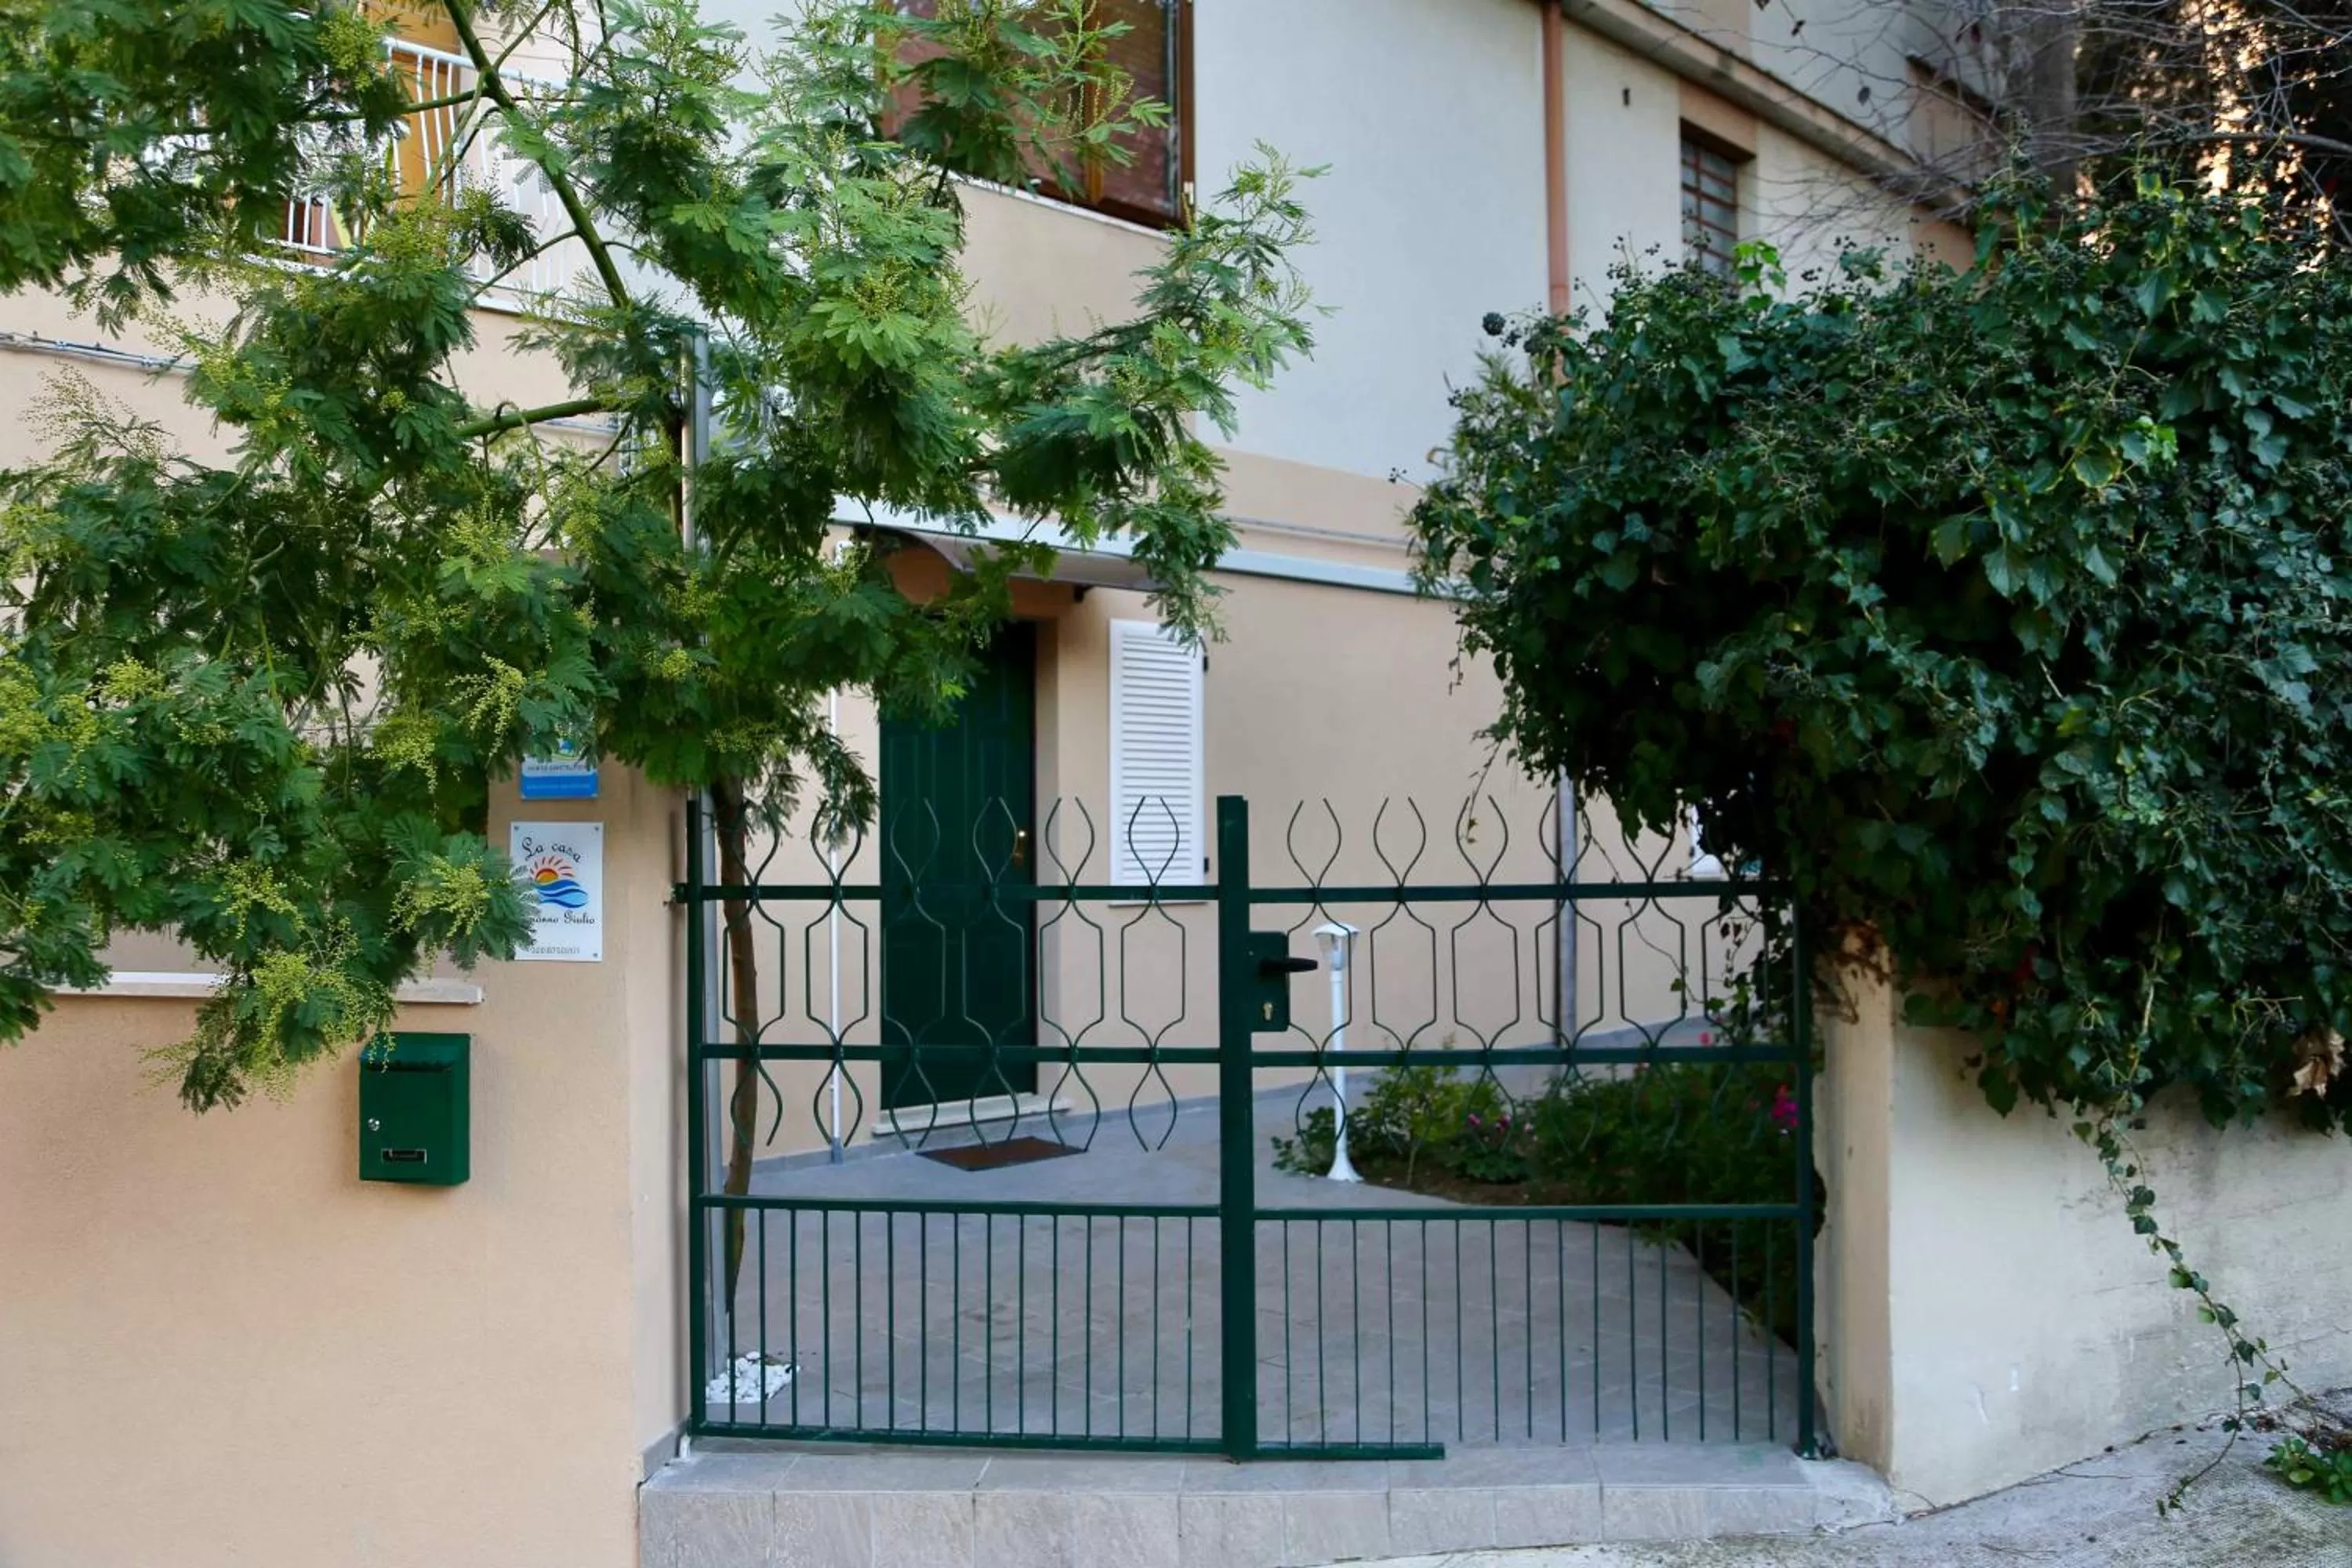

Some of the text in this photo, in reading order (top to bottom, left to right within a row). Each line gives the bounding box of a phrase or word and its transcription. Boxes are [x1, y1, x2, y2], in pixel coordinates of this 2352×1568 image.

[521, 837, 581, 862] La casa
[564, 909, 595, 924] Giulio
